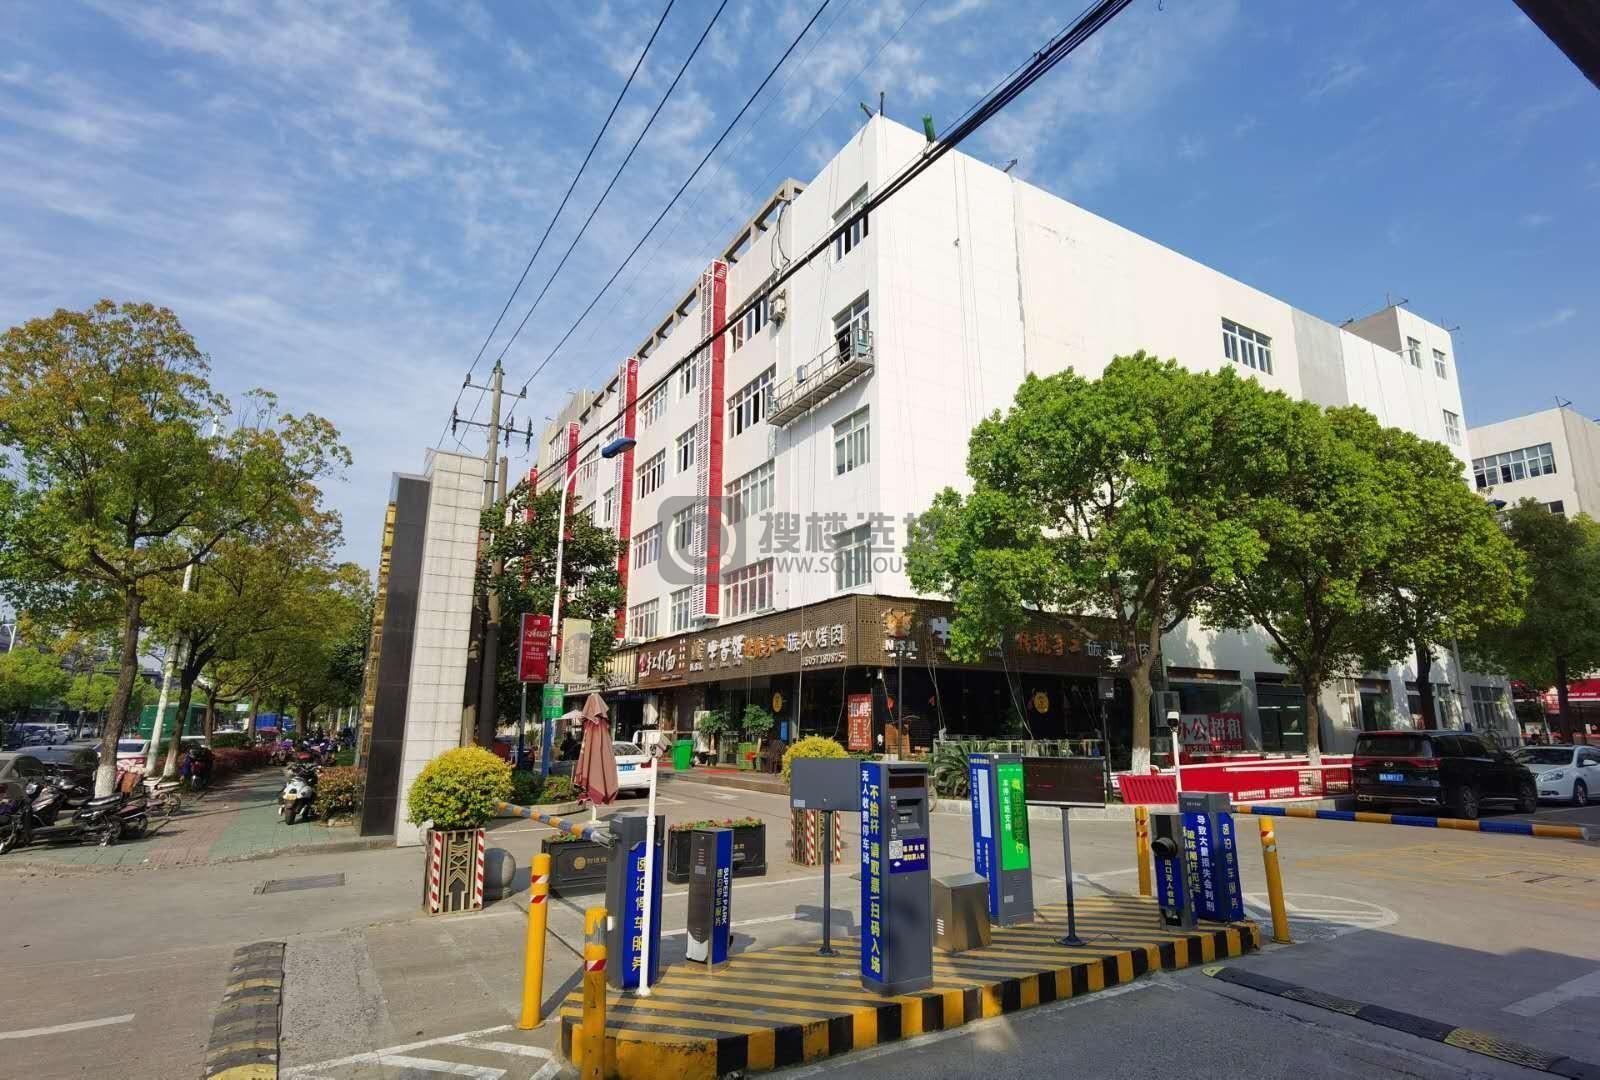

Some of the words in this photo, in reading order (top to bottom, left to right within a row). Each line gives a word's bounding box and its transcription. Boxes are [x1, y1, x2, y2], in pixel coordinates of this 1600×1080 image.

[862, 770, 870, 865] 无人收费停车场
[1197, 815, 1215, 912] 导致大量损失会判刑
